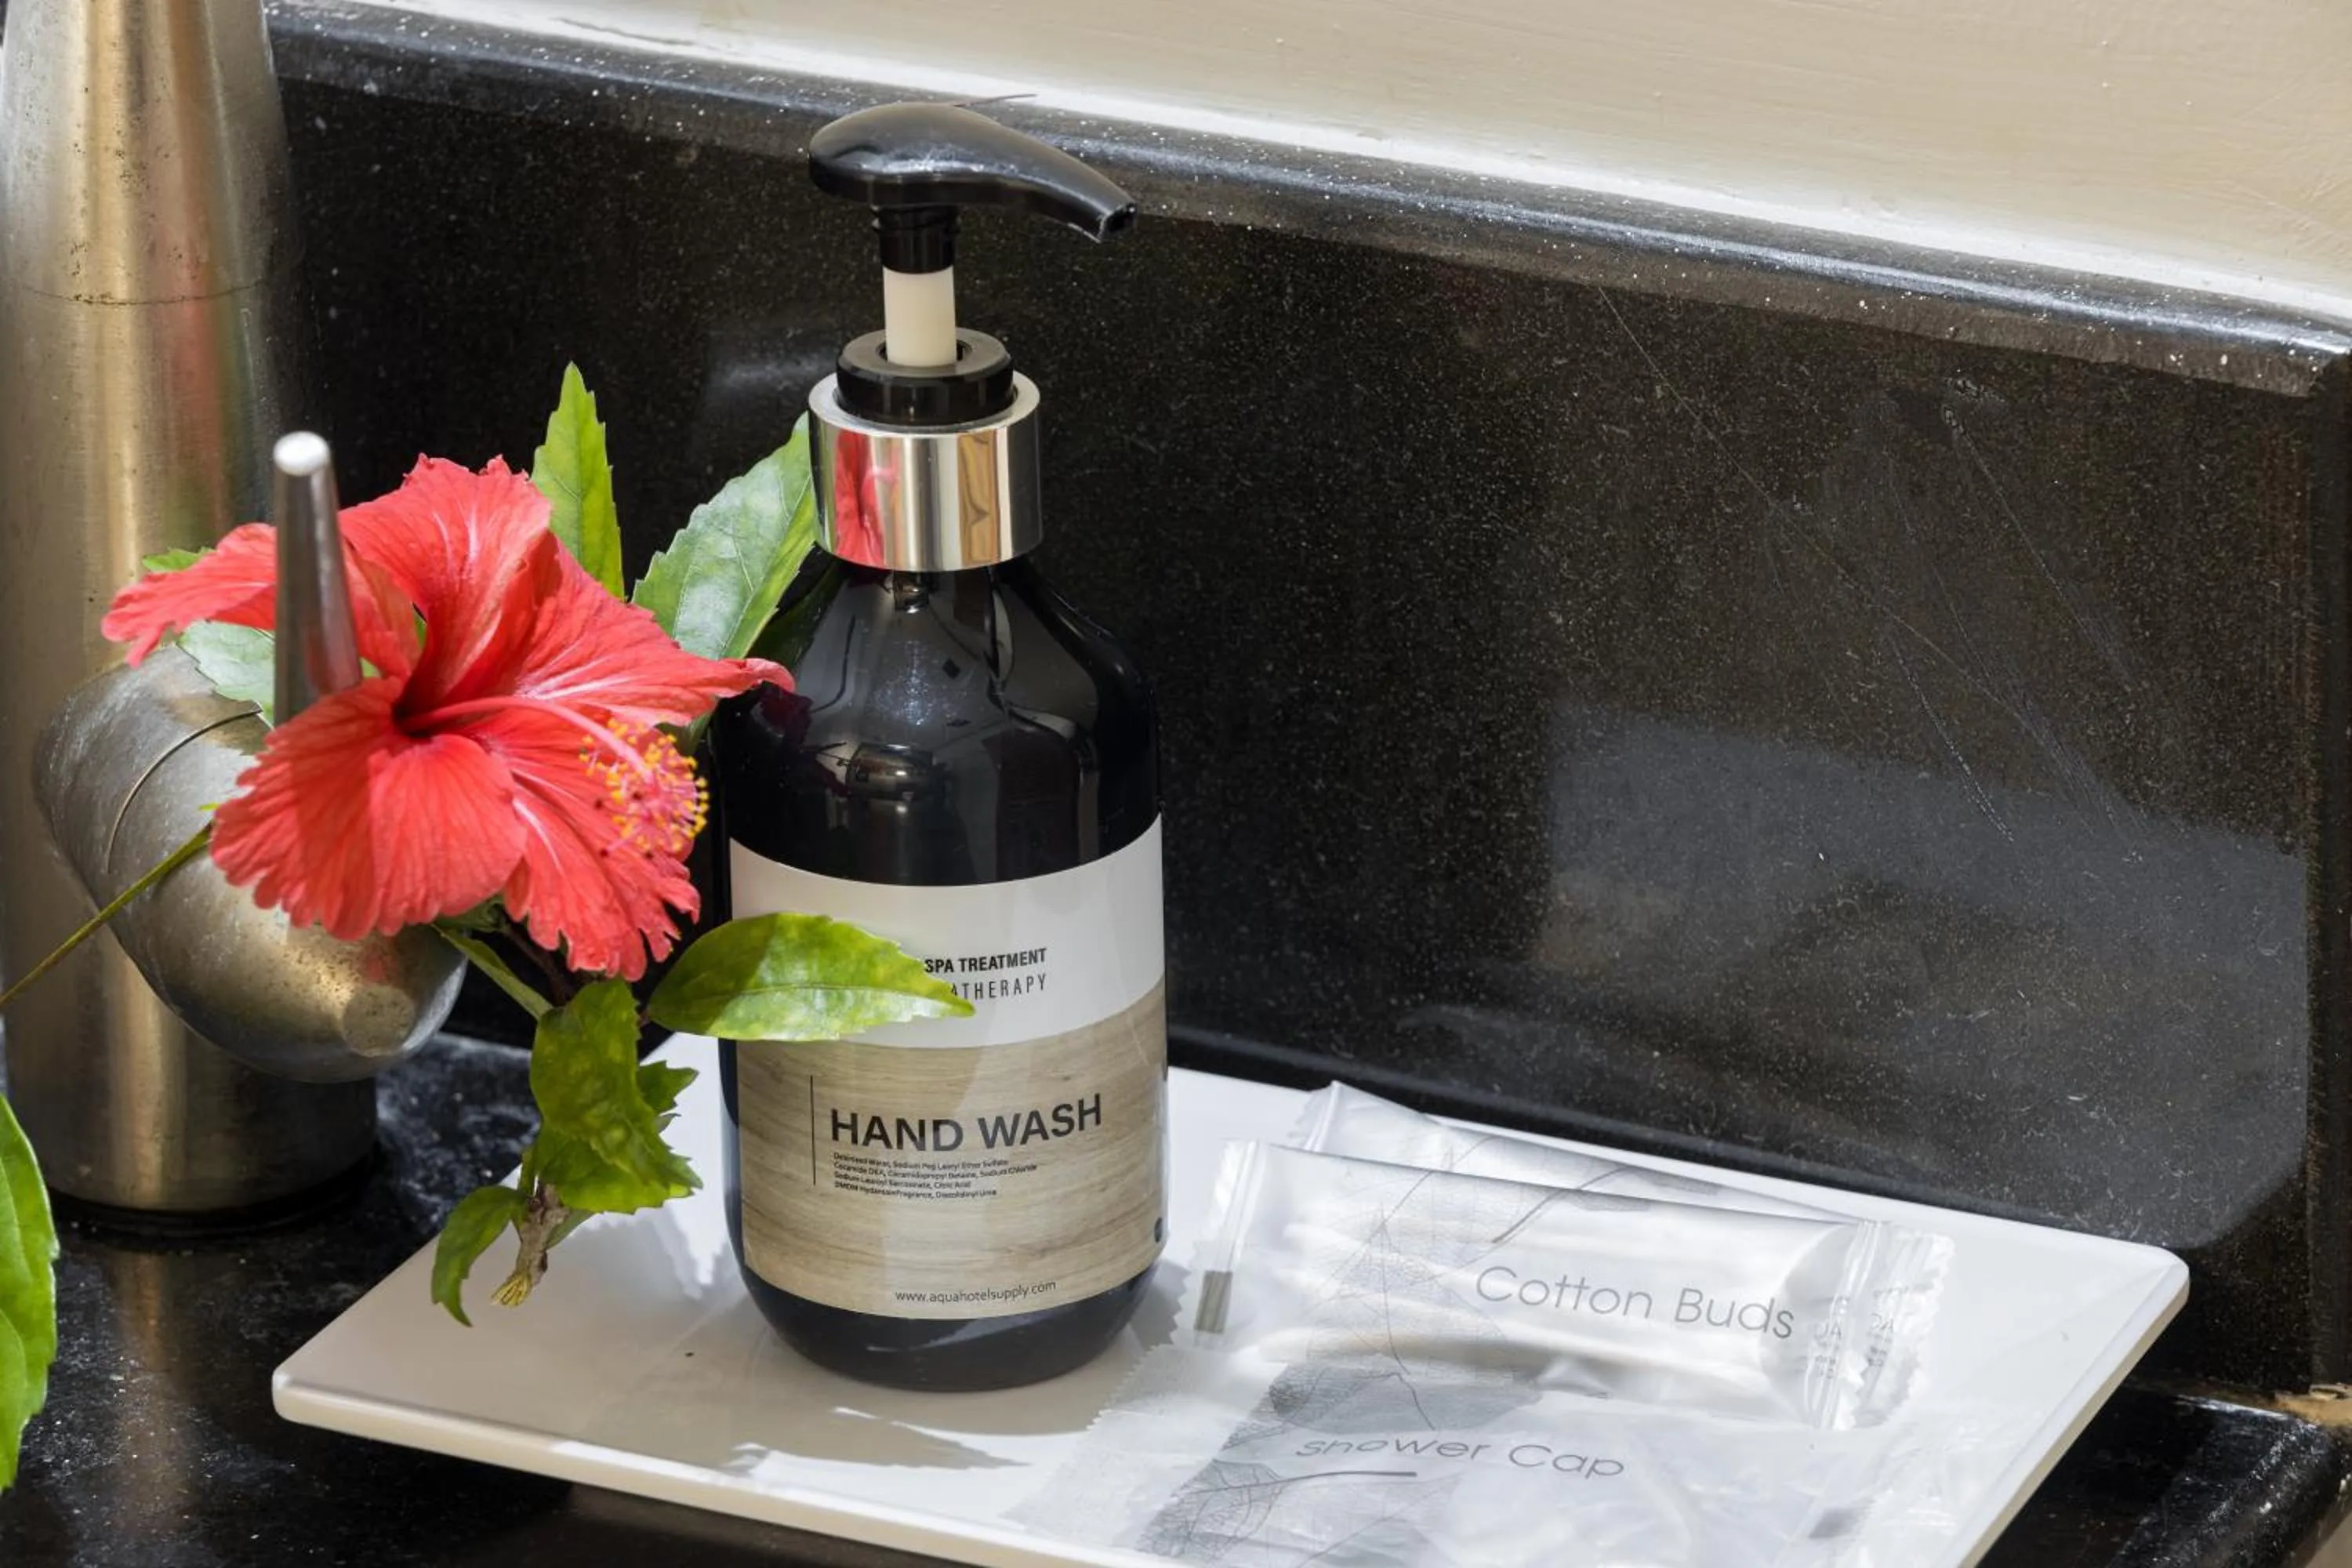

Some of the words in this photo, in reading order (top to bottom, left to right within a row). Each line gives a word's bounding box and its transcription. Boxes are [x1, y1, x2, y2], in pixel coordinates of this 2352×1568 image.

[924, 958, 954, 973] SPA
[959, 947, 1047, 972] TREATMENT
[831, 1108, 964, 1152] HAND
[978, 1093, 1102, 1149] WASH
[895, 1280, 1056, 1305] www.aquahotelsupply.com
[1476, 1266, 1653, 1319] Cotton
[1675, 1287, 1795, 1340] Buds
[1508, 1444, 1624, 1480] Cap
